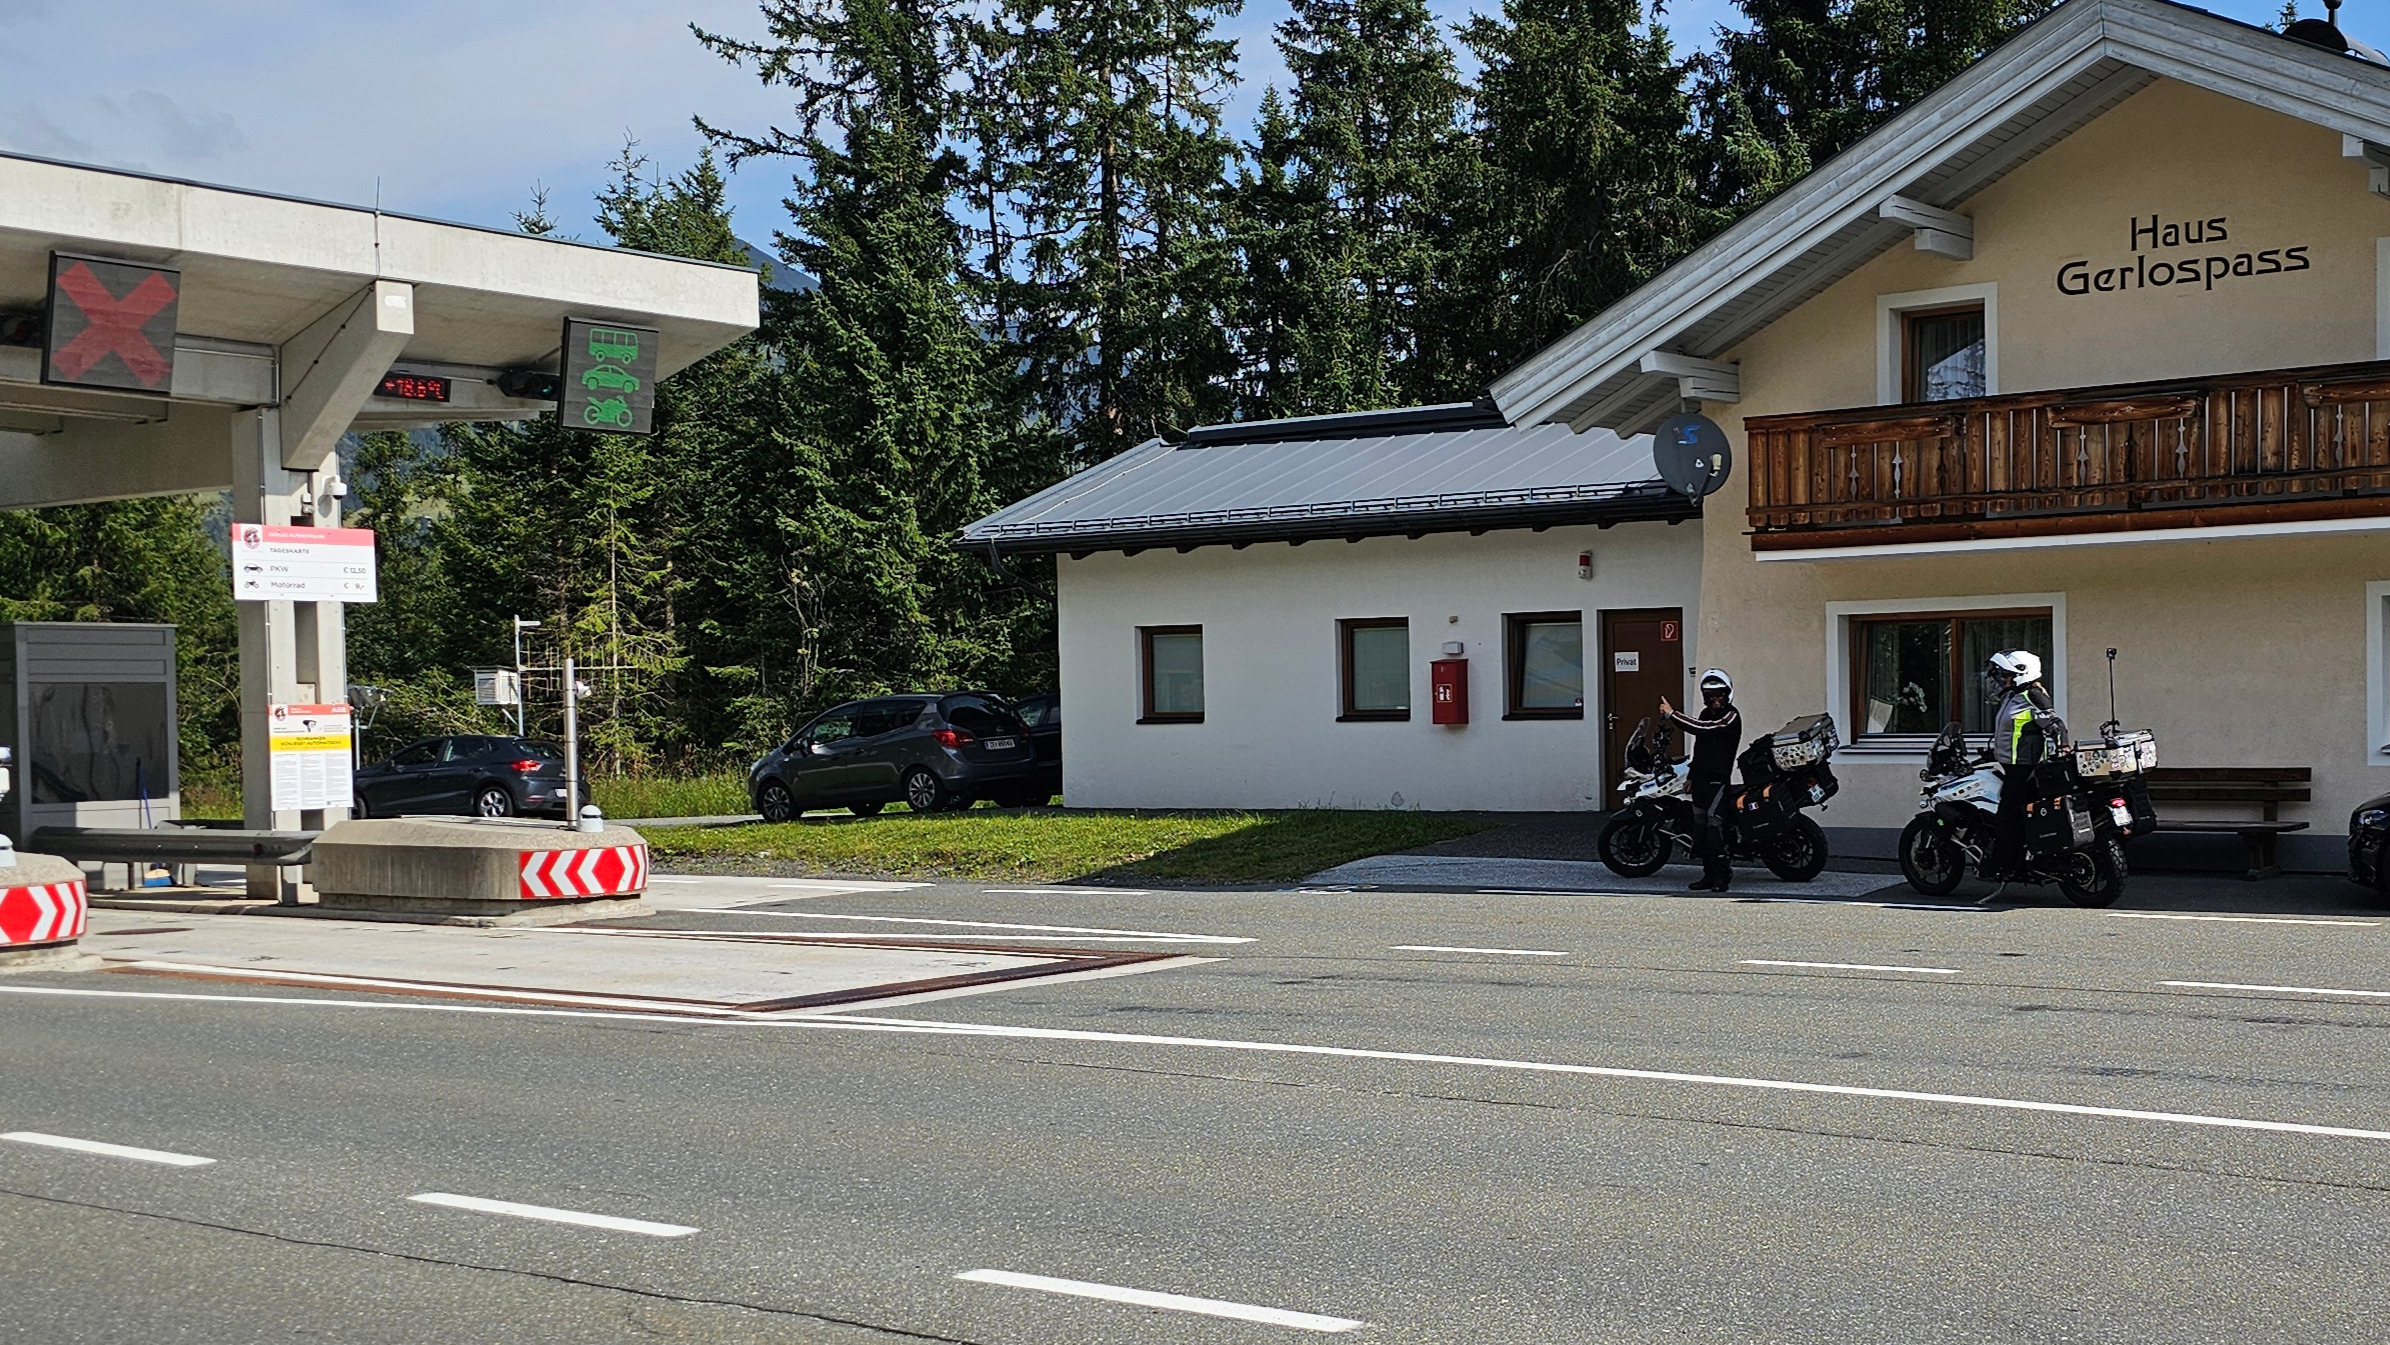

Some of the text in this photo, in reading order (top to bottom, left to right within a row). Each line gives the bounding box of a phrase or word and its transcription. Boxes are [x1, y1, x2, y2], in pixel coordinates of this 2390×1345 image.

[2130, 214, 2228, 251] Haus
[2056, 245, 2310, 296] Gerlospass
[269, 547, 310, 555] TAGESKARTE
[271, 581, 306, 589] Motorrad
[1616, 657, 1637, 666] Privat
